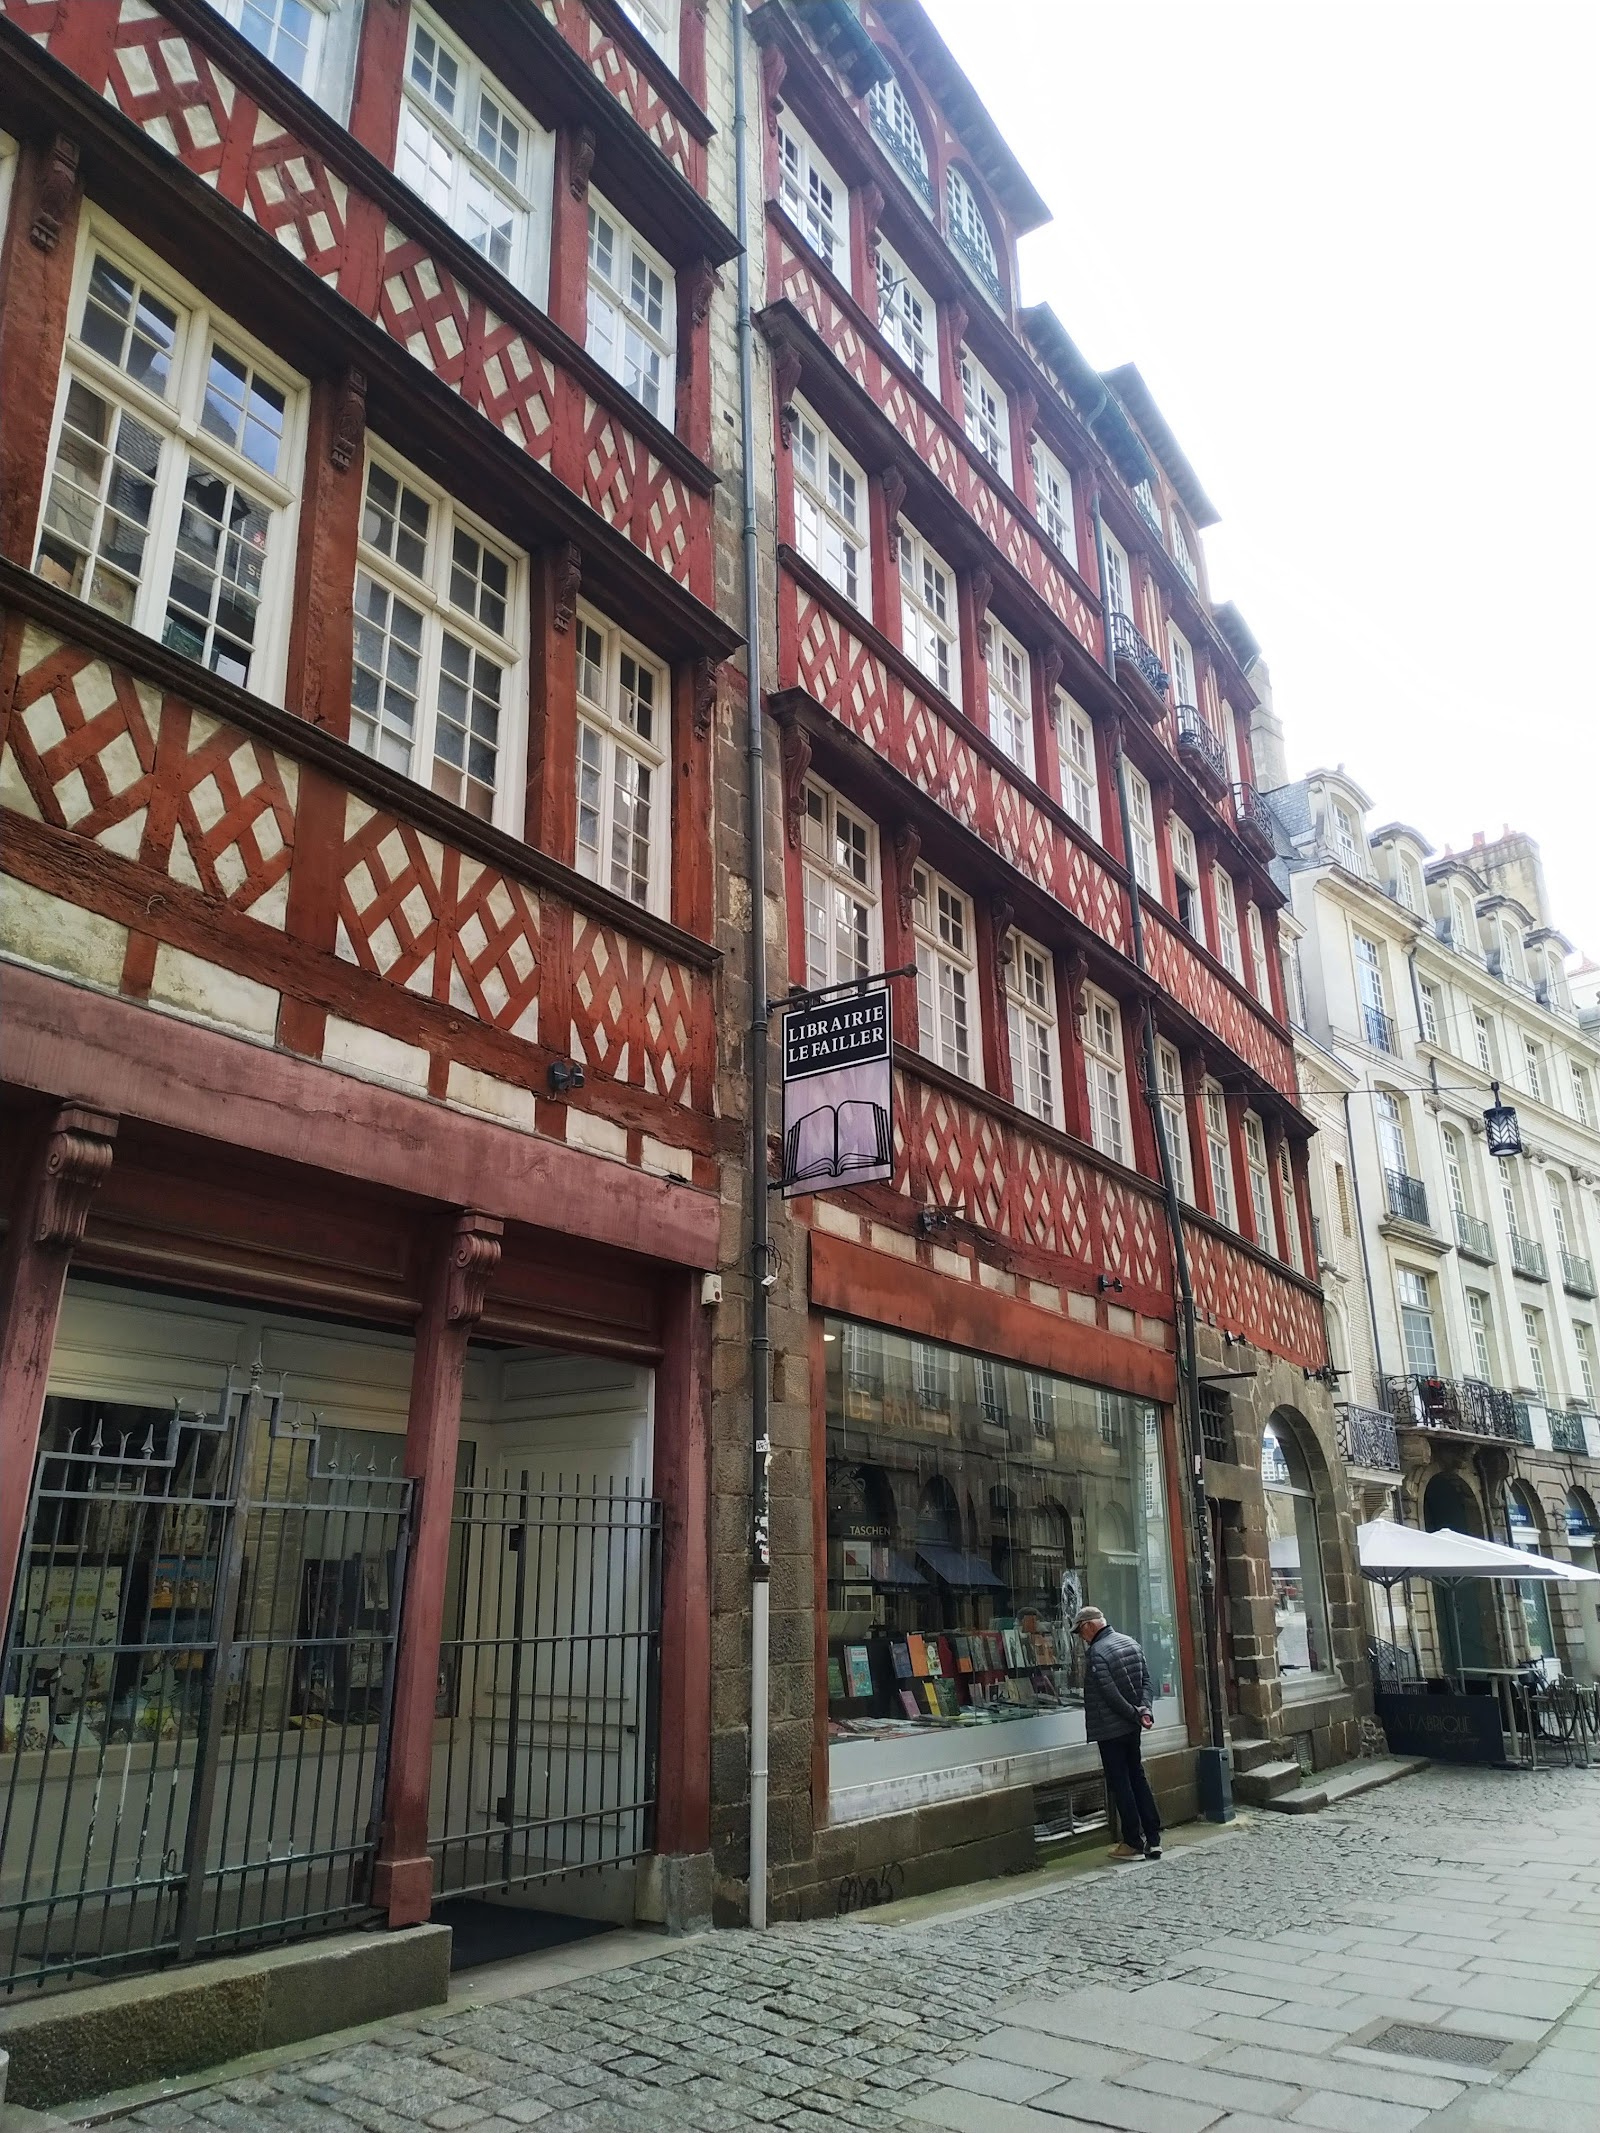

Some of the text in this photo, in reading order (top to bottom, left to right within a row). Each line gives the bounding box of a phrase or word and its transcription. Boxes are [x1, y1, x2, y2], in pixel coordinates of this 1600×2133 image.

[788, 1005, 884, 1043] LIBRAIRIE
[788, 1027, 884, 1063] LE FAILLER
[849, 1525, 891, 1536] TASCHEN
[1408, 1713, 1473, 1734] FABRIQUE
